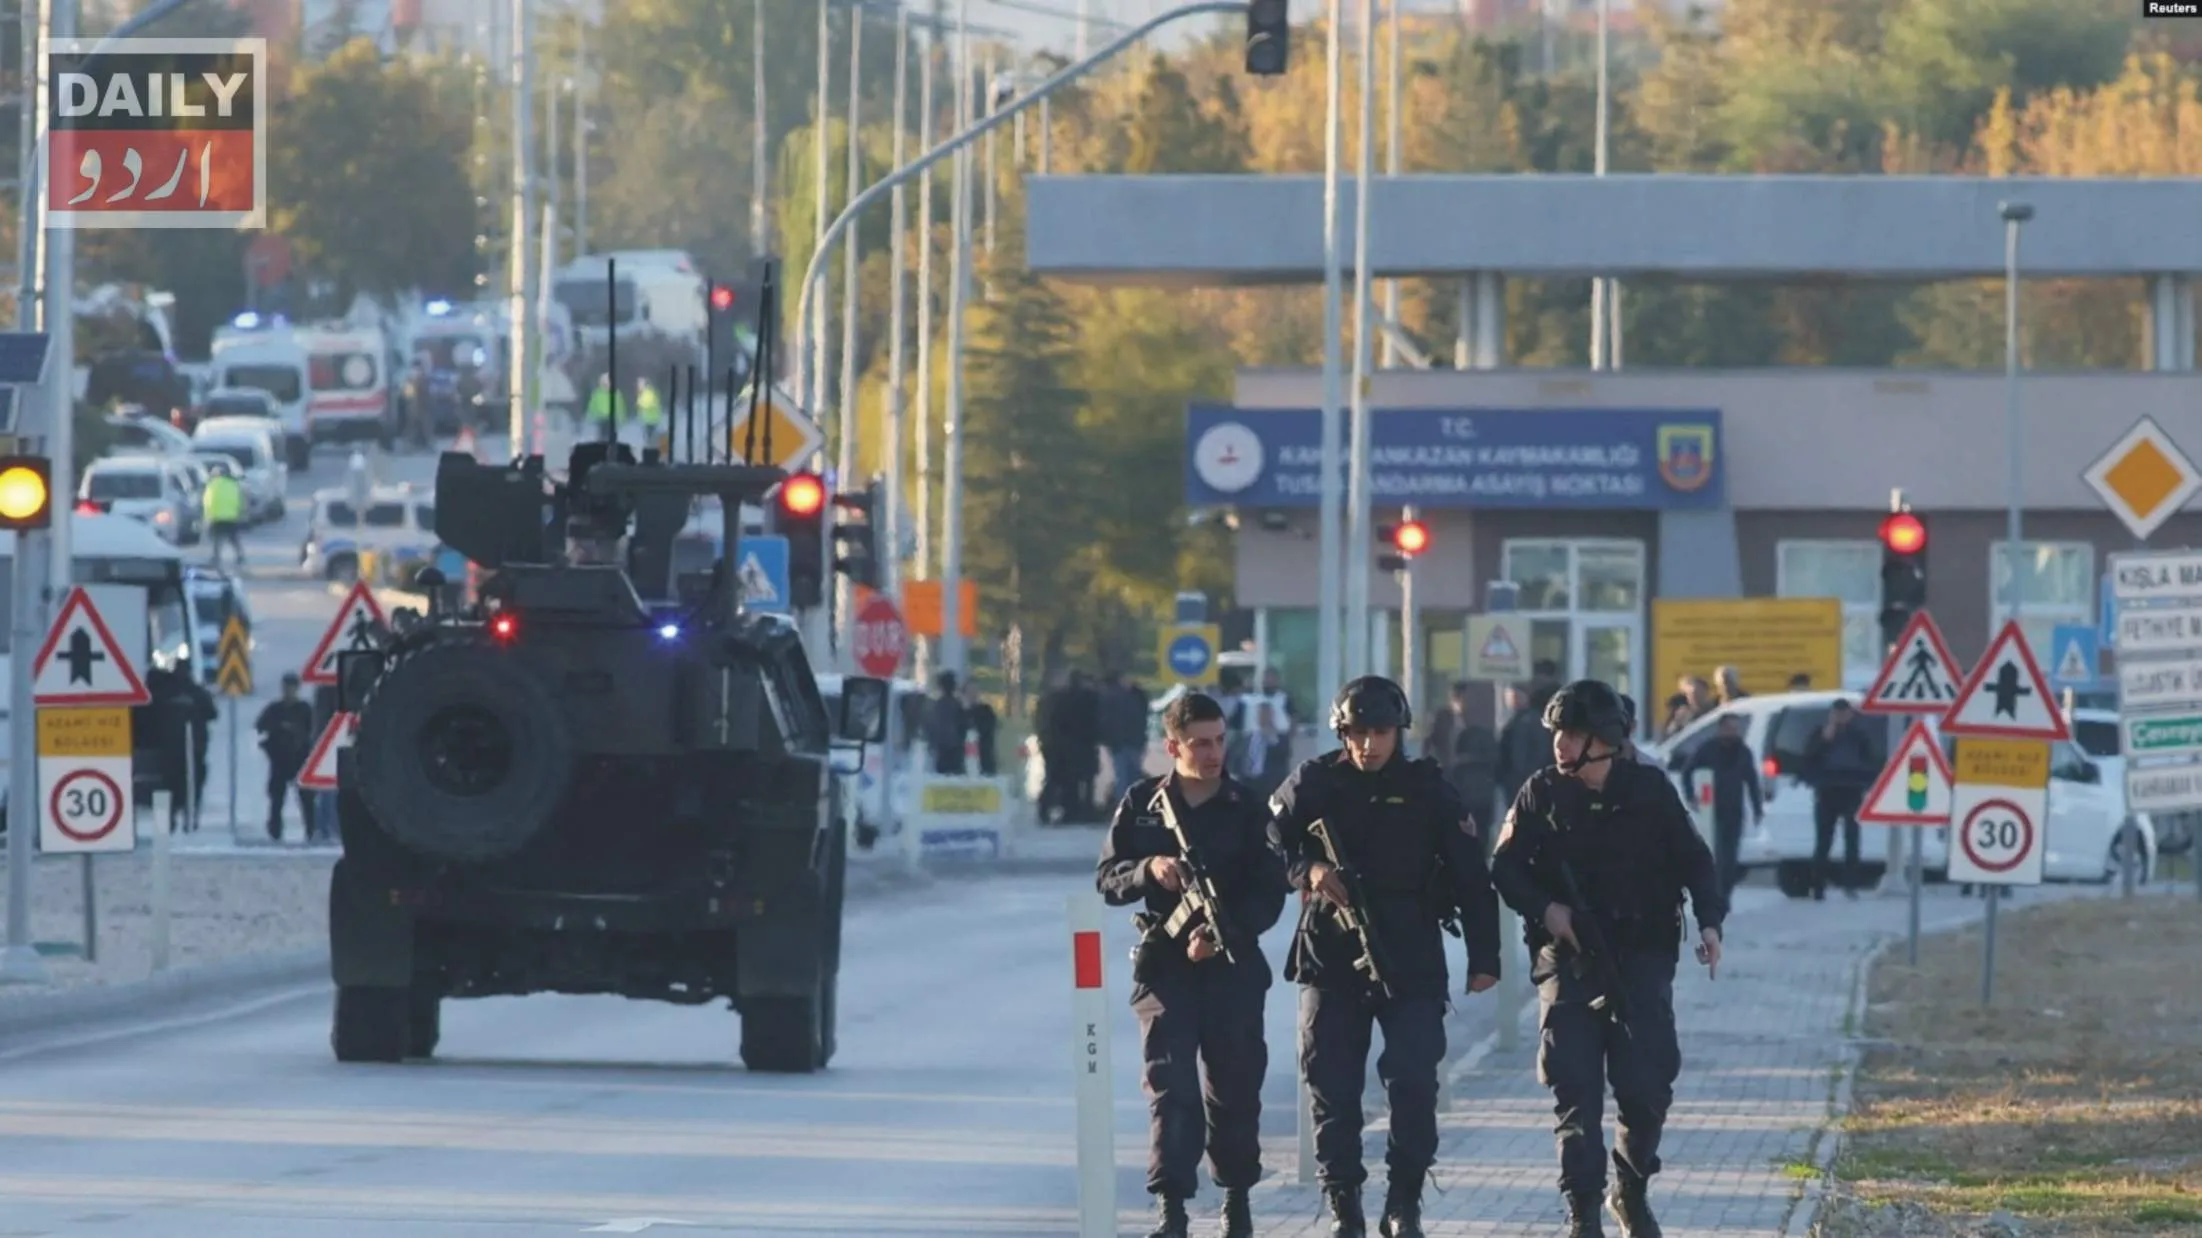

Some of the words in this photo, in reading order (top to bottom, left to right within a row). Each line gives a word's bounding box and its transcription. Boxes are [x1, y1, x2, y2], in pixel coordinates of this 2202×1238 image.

[66, 788, 107, 818] 30
[1977, 820, 2018, 850] 30
[1086, 1023, 1097, 1074] KGM
